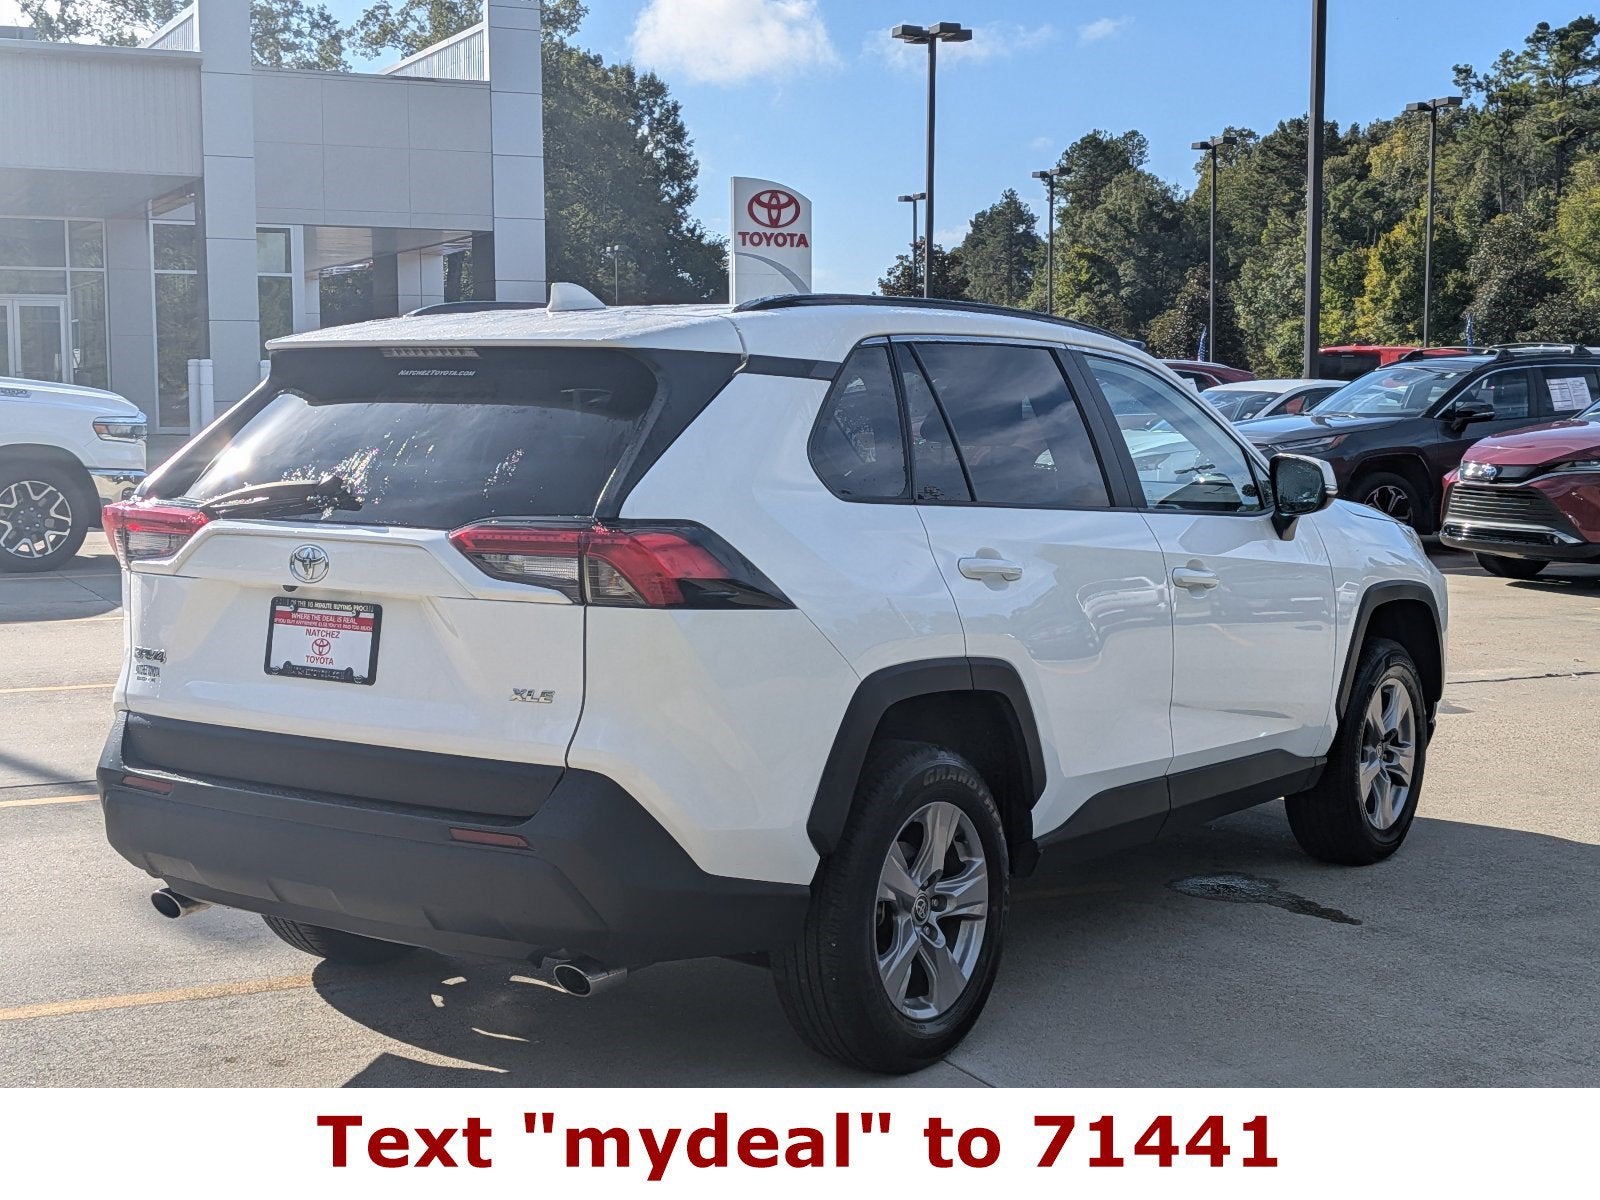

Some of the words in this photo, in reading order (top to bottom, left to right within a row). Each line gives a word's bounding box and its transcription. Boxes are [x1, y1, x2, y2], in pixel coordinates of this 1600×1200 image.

[737, 231, 809, 248] TOYOTA
[314, 601, 333, 609] MINUTE
[333, 603, 353, 611] BUYING
[291, 612, 311, 621] WHERE
[311, 614, 321, 622] THE
[321, 615, 336, 623] DEAL
[305, 628, 341, 639] NATCHEZ
[305, 655, 334, 666] TOYOTA
[510, 687, 556, 704] XLE
